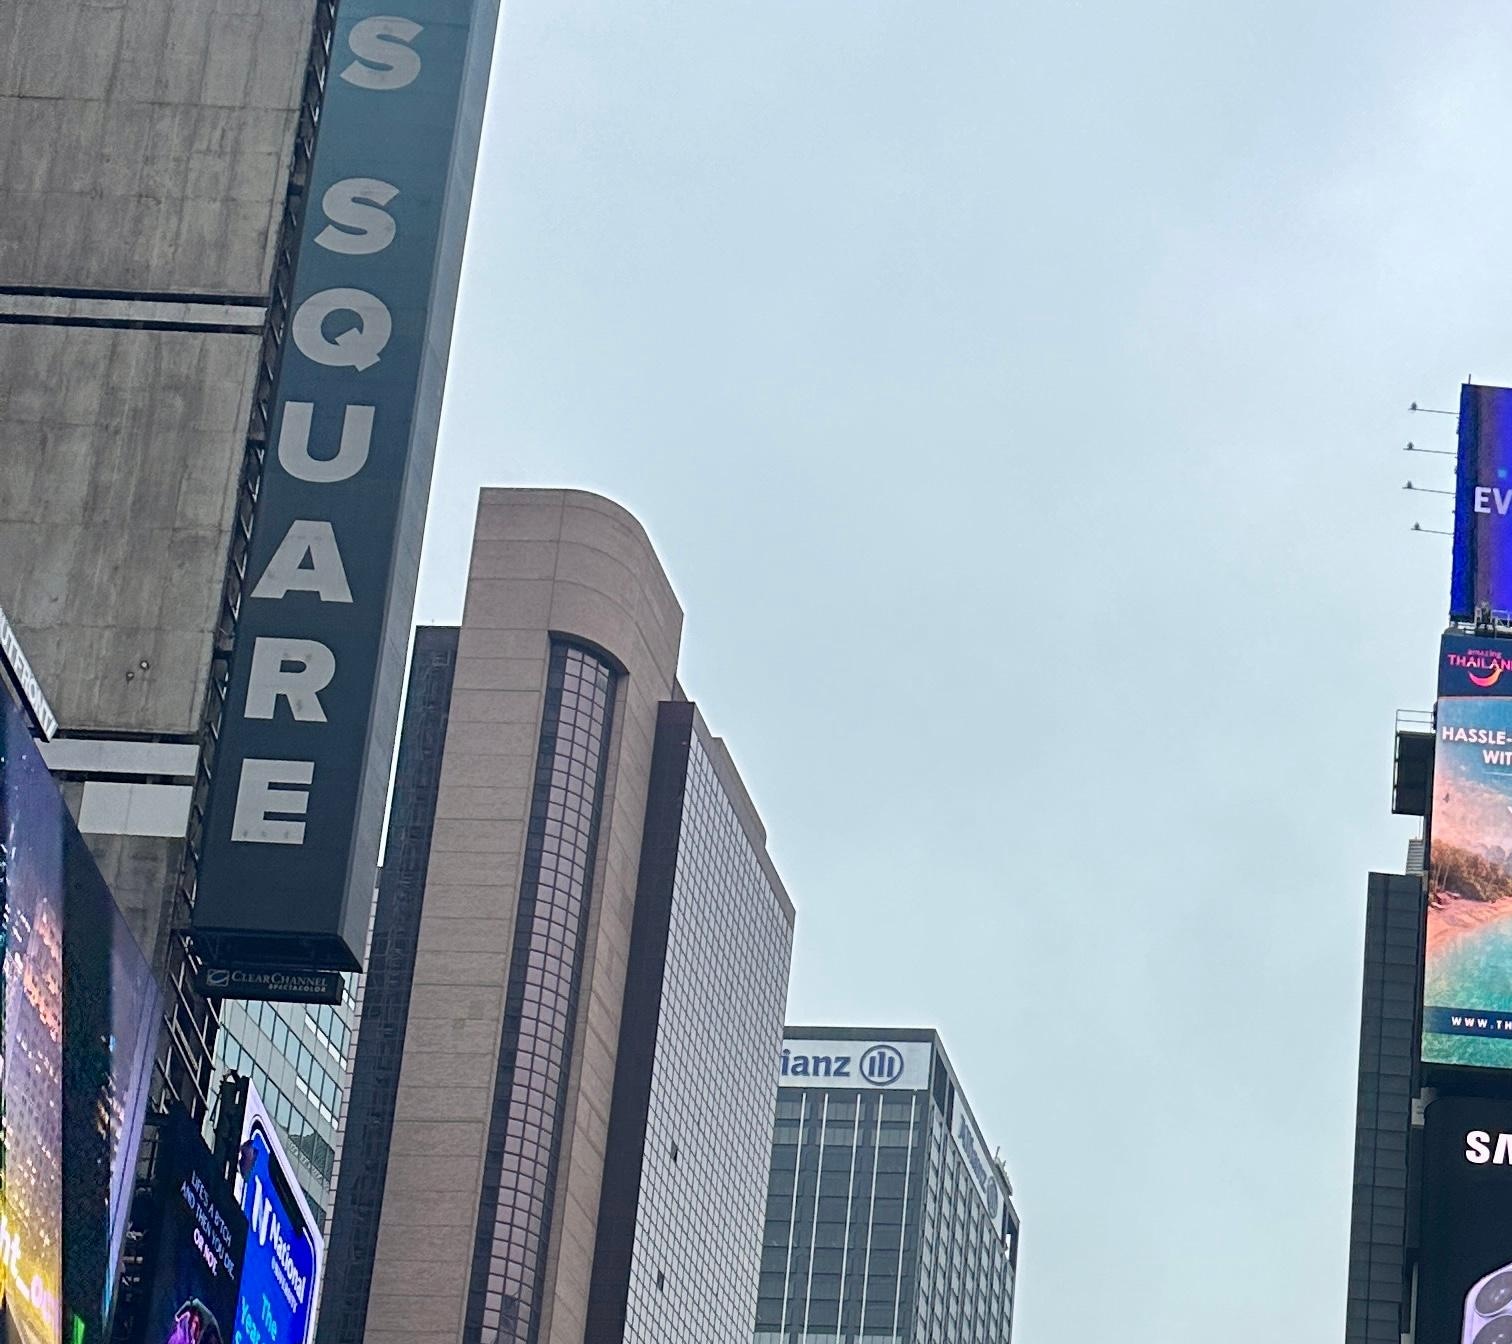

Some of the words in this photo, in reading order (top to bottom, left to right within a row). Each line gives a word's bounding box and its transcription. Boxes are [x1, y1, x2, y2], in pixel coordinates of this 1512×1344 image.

[230, 176, 400, 846] SQUARE
[780, 1049, 851, 1078] ianz
[270, 1213, 307, 1305] National
[262, 1293, 278, 1341] The
